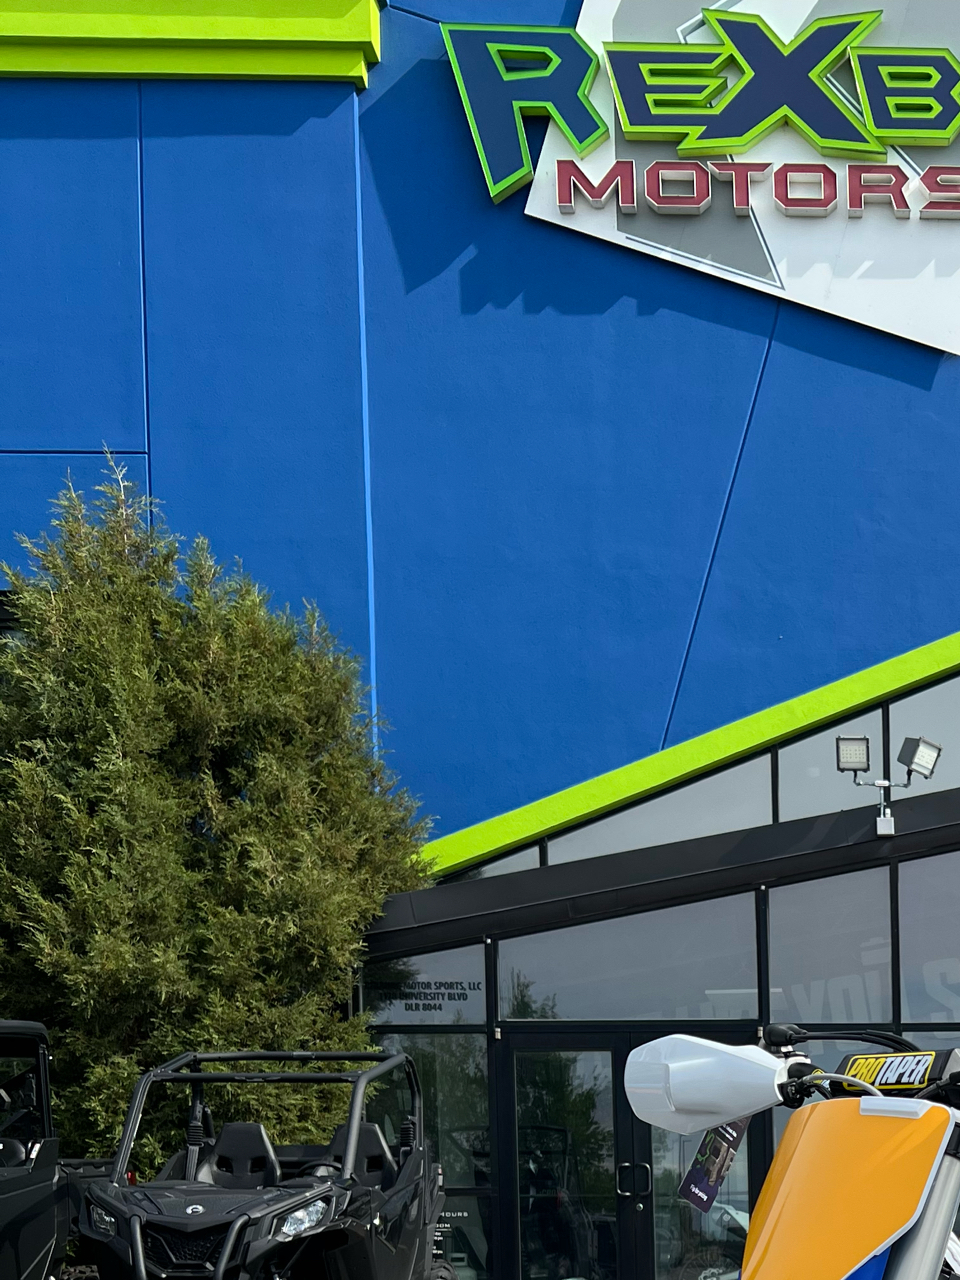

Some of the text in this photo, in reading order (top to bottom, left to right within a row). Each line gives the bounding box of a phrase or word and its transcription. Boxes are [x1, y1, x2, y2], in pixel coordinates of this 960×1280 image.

[469, 982, 482, 991] LLC
[447, 992, 468, 1001] BLVD
[405, 1002, 443, 1011] DLR 8044
